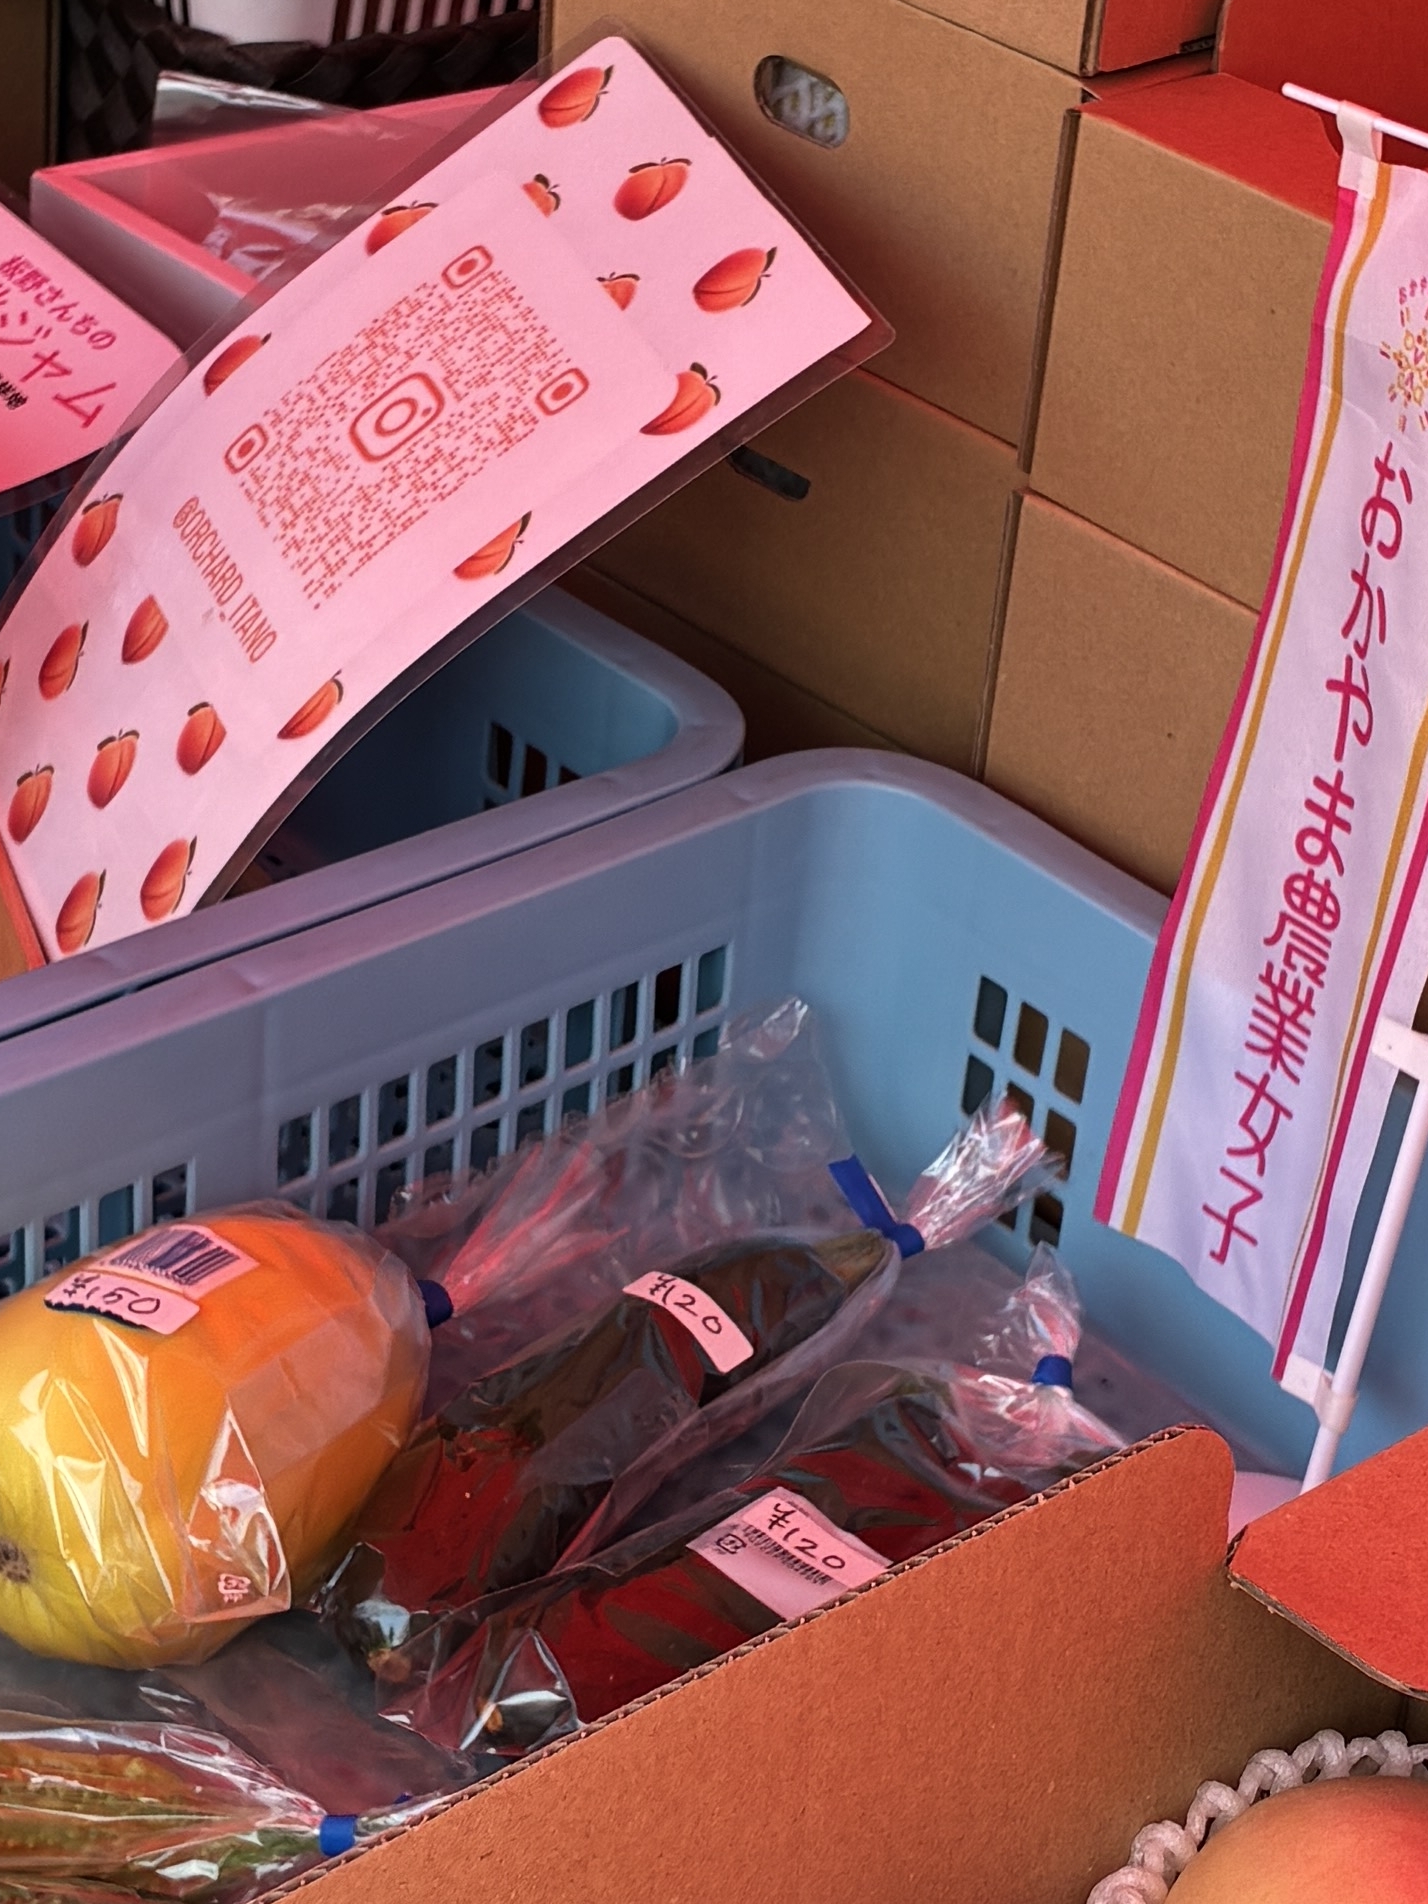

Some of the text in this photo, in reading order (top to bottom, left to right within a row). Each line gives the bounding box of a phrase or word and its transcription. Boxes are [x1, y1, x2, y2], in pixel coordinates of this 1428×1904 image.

[172, 496, 279, 663] @ORCHARD_ITANO
[1201, 441, 1416, 1266] おかやま農業女子
[767, 1502, 846, 1570] ¥120
